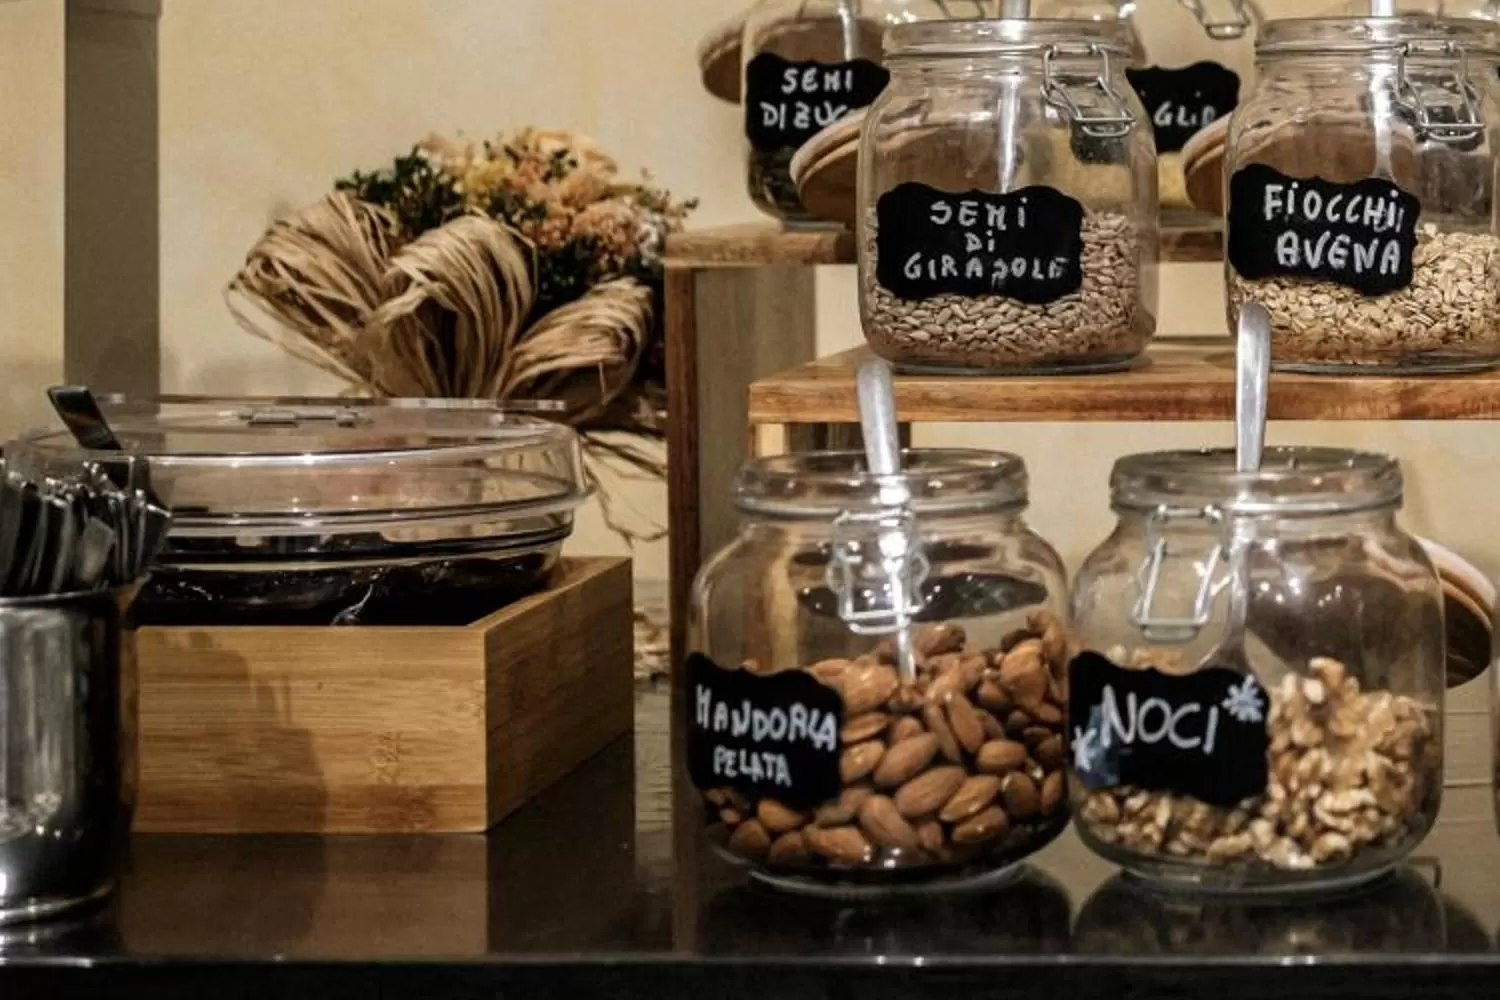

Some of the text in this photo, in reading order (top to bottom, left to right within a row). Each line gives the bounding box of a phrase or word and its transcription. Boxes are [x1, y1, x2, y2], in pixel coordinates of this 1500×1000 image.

[781, 66, 853, 94] SEMI
[1276, 230, 1401, 274] AVENA
[1100, 684, 1220, 755] NOCI
[712, 744, 793, 788] PELATA
